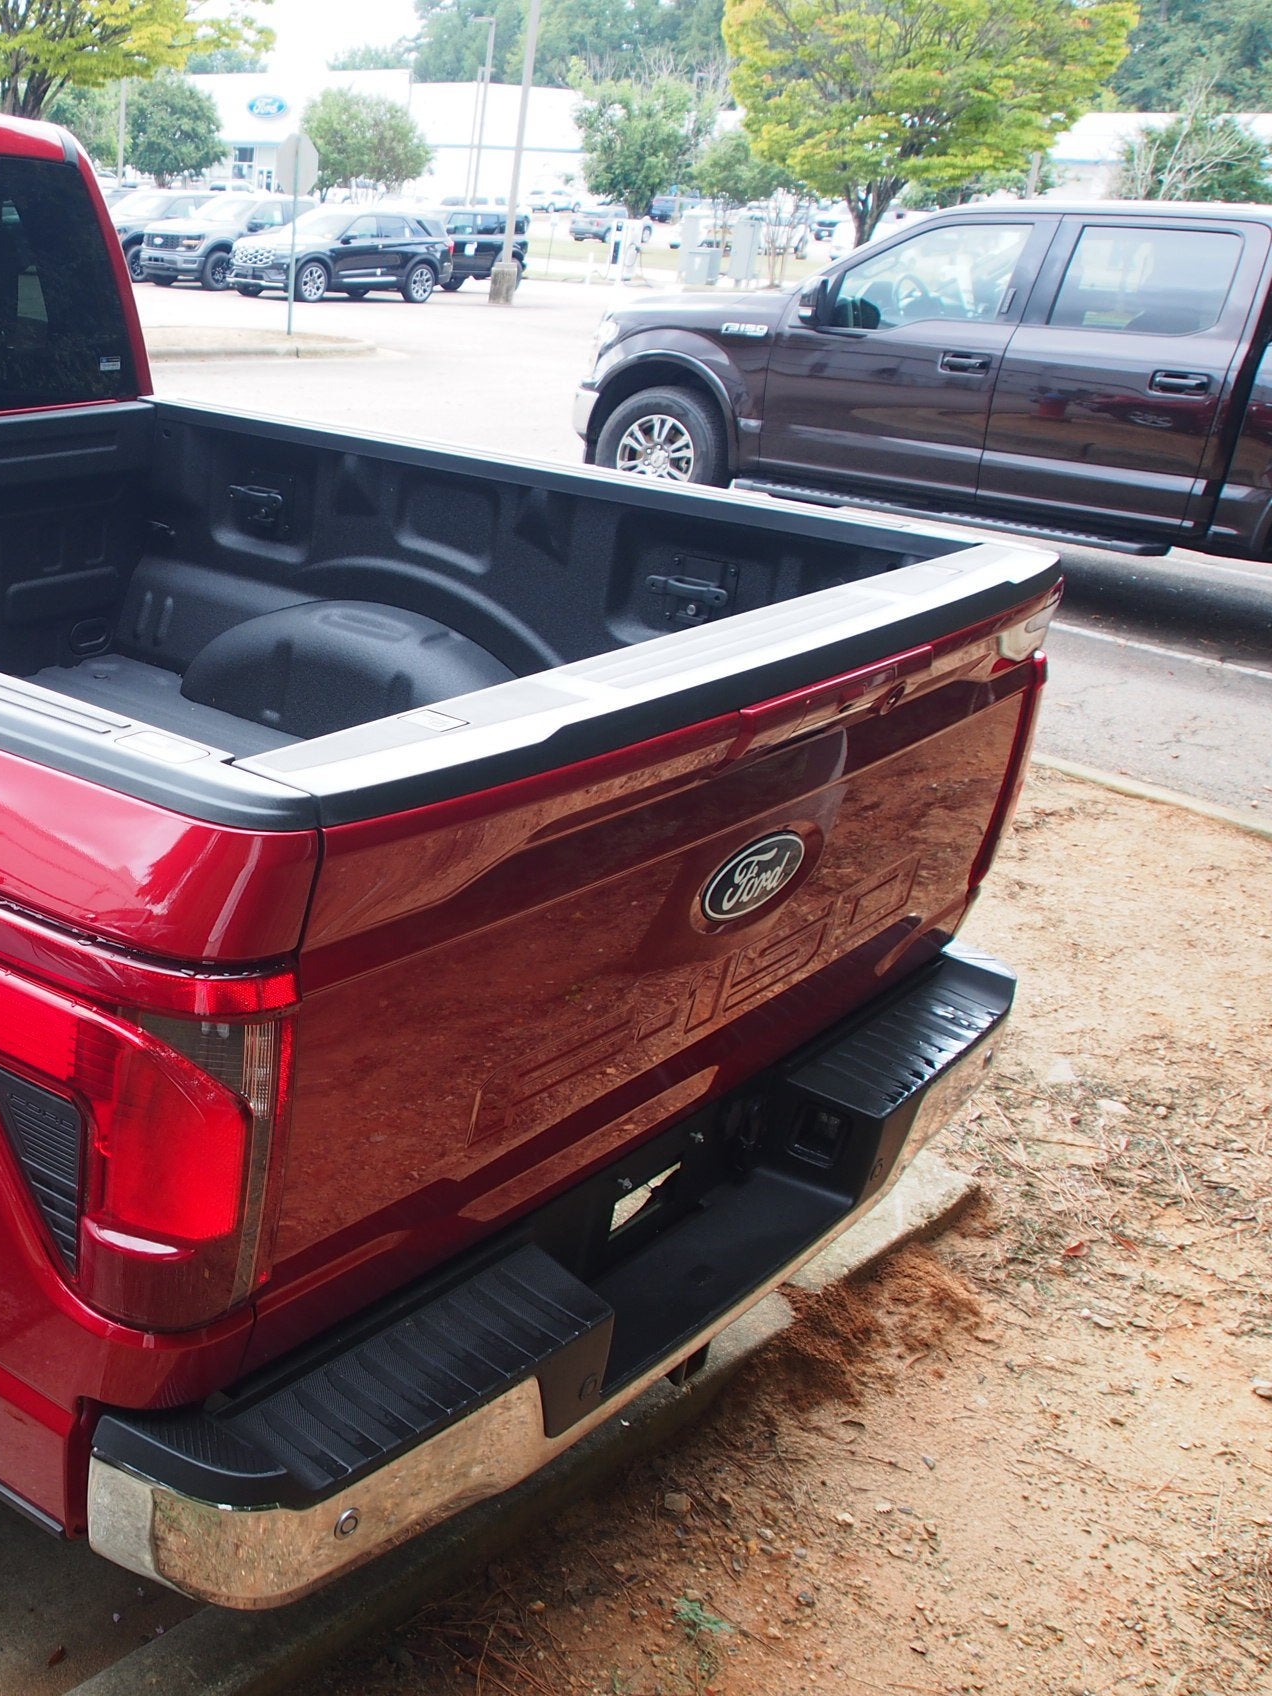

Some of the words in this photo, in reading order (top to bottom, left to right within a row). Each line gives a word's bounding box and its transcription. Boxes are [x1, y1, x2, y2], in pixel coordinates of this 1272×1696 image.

[254, 98, 279, 113] Ford
[722, 847, 790, 911] Ford
[465, 852, 921, 1148] F-150
